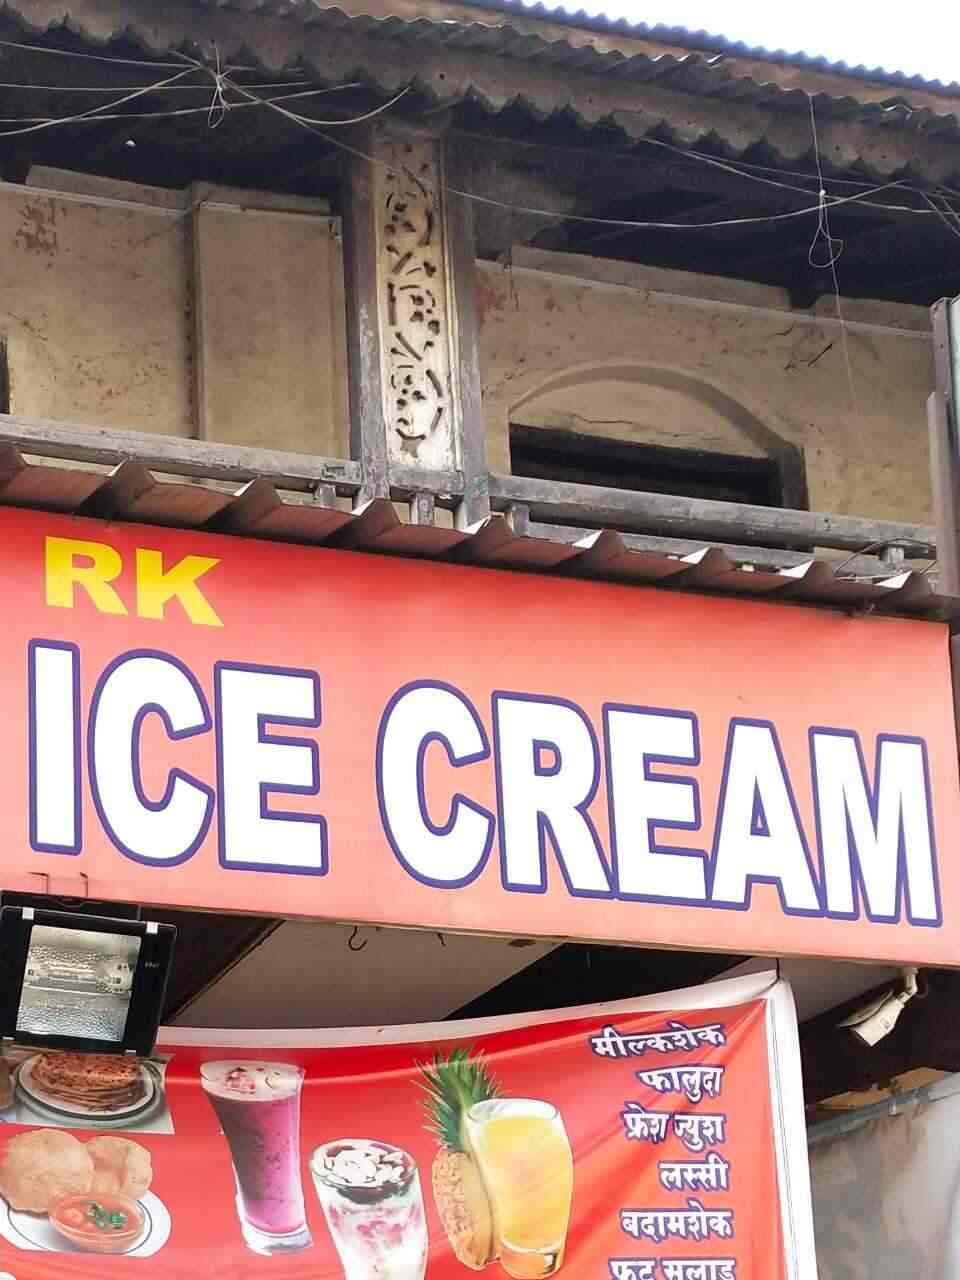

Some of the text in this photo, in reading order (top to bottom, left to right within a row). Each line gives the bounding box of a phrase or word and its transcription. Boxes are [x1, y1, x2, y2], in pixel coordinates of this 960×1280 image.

[44, 536, 224, 626] RK
[28, 639, 329, 877] ICE
[376, 679, 943, 928] CREAM
[637, 1064, 725, 1104] फालुदा
[658, 1153, 730, 1192] लस्सी
[619, 1200, 734, 1244] बदामशेक
